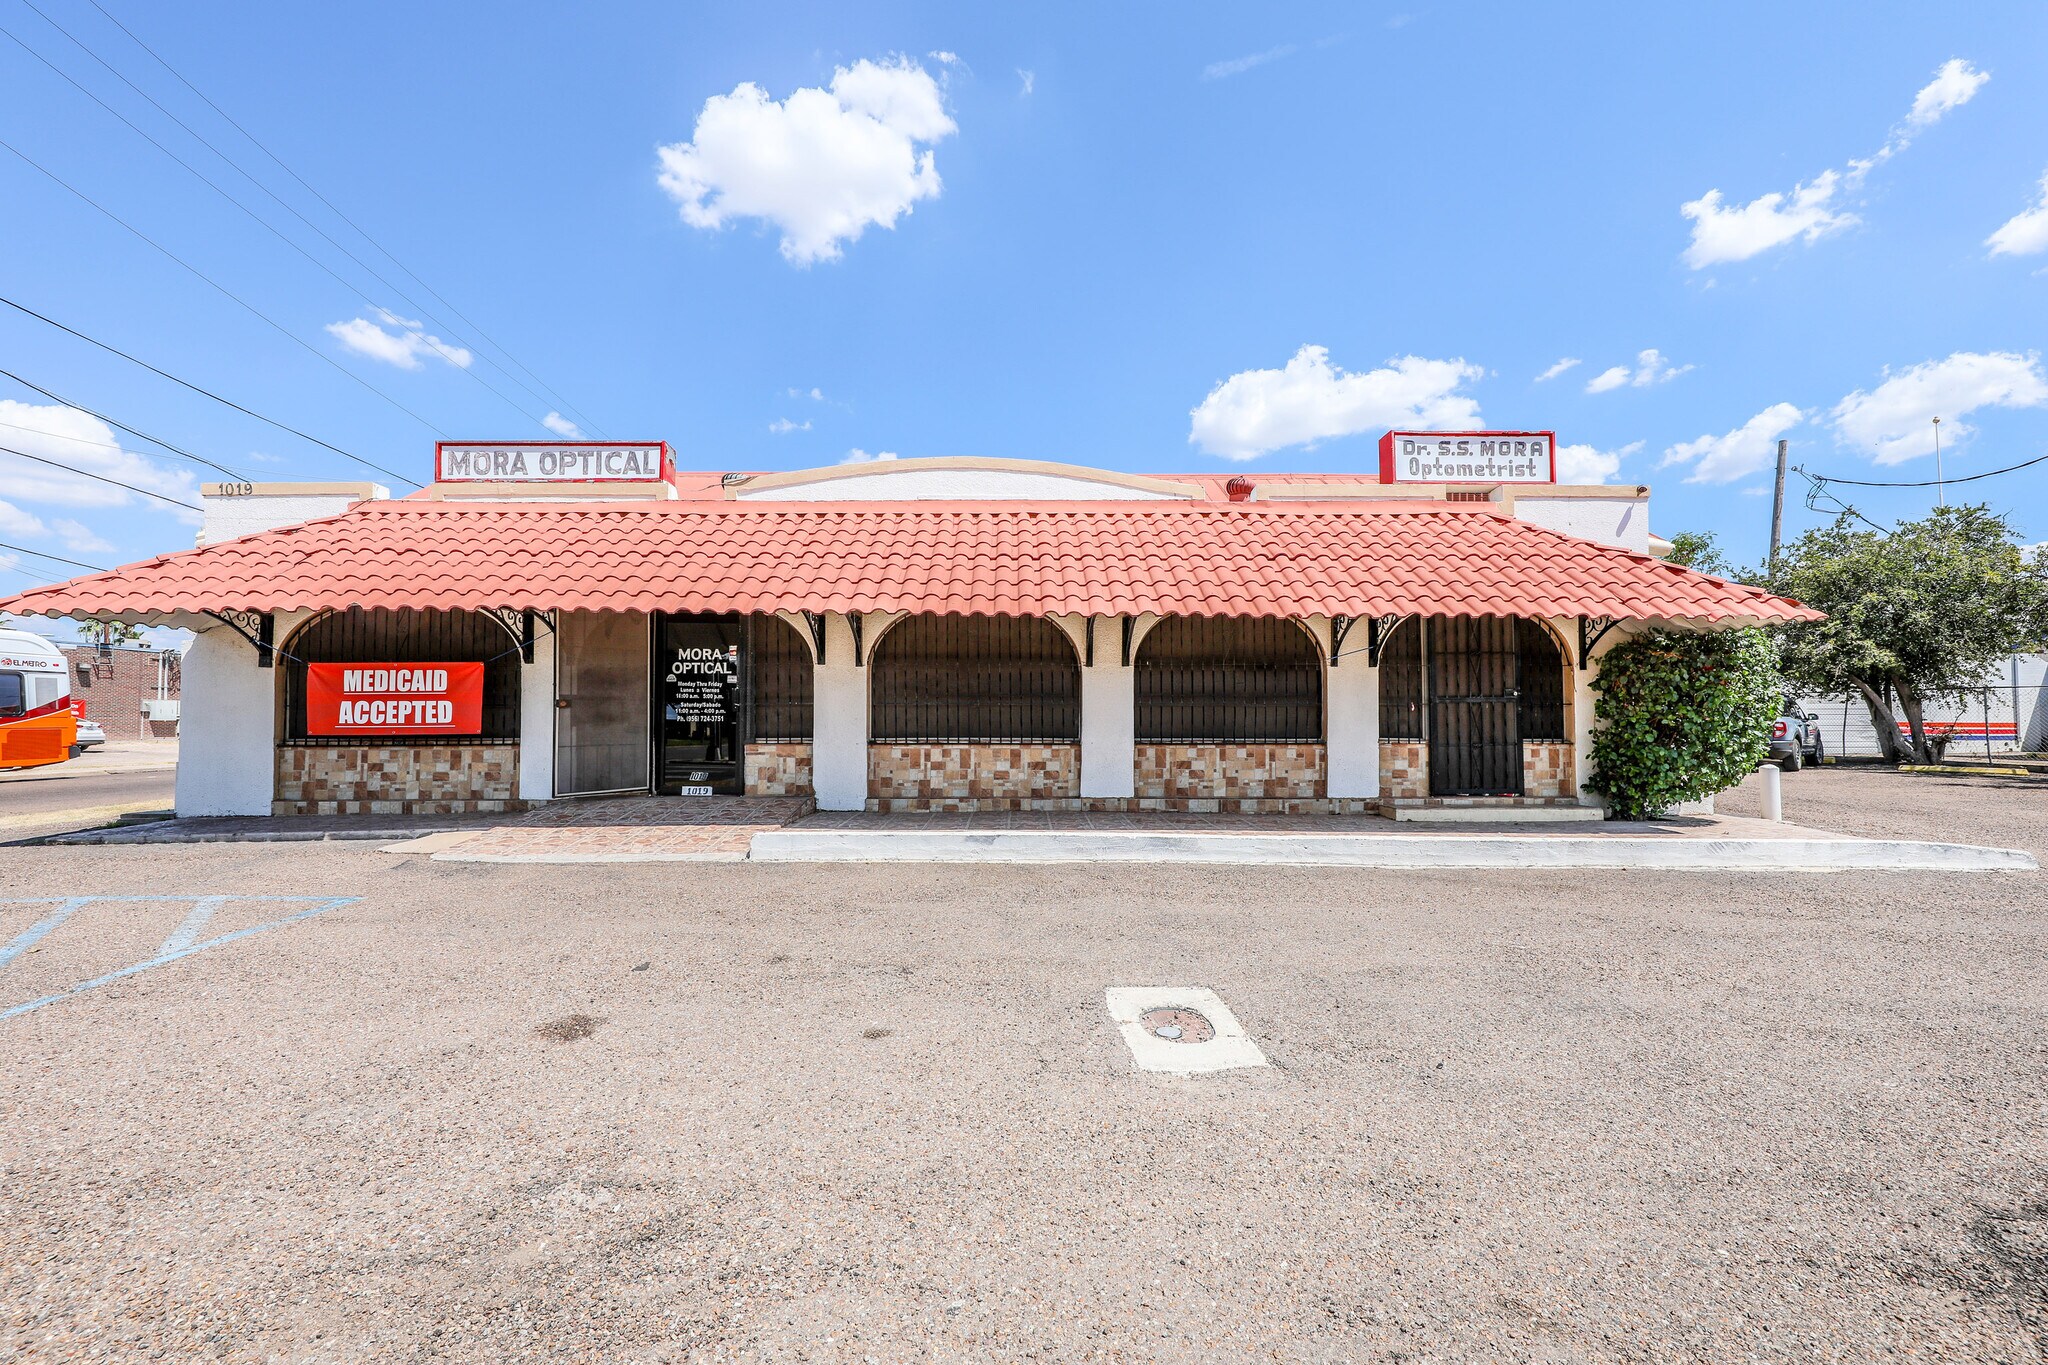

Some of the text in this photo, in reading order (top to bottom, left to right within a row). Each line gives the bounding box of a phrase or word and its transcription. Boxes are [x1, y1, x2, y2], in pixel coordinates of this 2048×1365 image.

[1403, 440, 1543, 457] Dr. S.S. MORA
[447, 450, 656, 476] MORA OPTICAL
[1409, 457, 1537, 479] Optometrist
[219, 483, 253, 497] 1019
[678, 648, 722, 661] MORA
[672, 662, 732, 674] OPTICAL
[344, 669, 448, 692] MEDICAID
[338, 700, 453, 724] ACCEPTED
[687, 787, 709, 795] 1019
